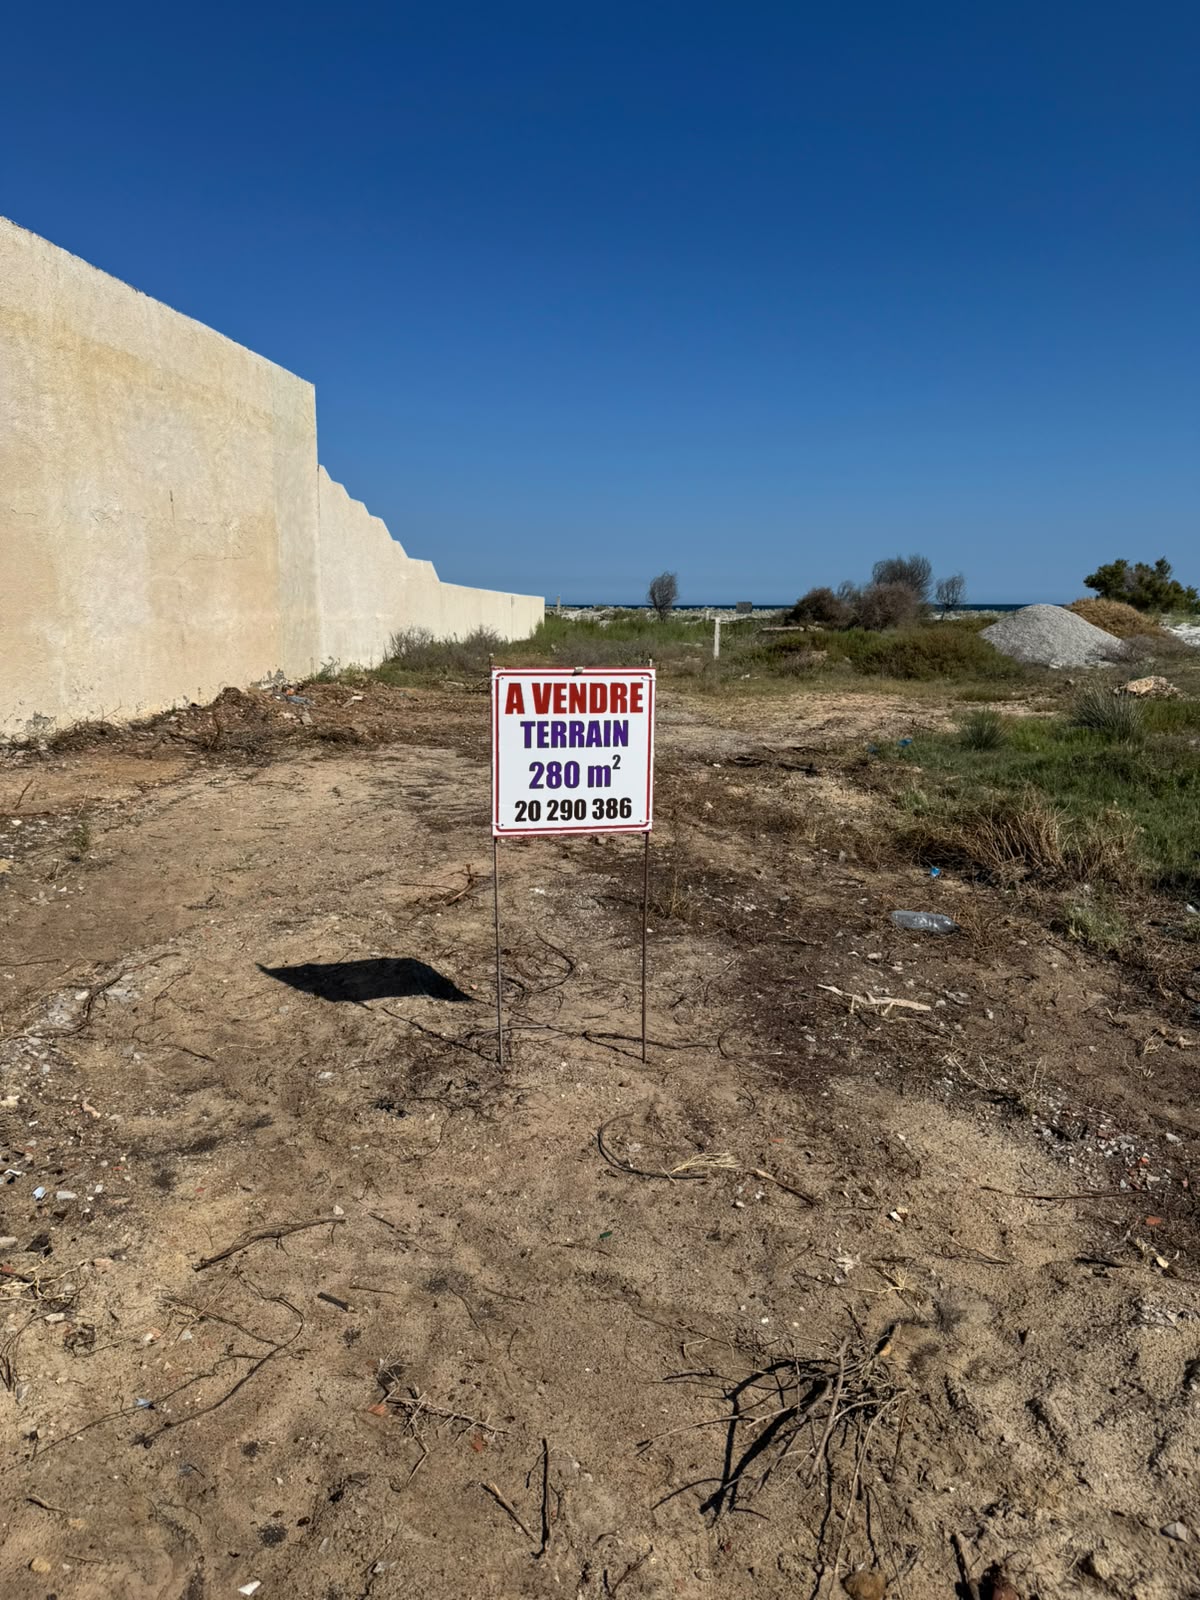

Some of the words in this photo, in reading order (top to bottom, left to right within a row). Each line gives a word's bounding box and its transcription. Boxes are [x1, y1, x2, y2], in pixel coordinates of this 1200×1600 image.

[505, 682, 525, 715] A
[532, 682, 644, 715] VENDRE
[520, 719, 629, 749] TERRAIN
[529, 760, 580, 790] 280
[587, 754, 621, 788] m²
[514, 800, 542, 822] 20
[546, 799, 587, 821] 290
[592, 797, 632, 820] 386
